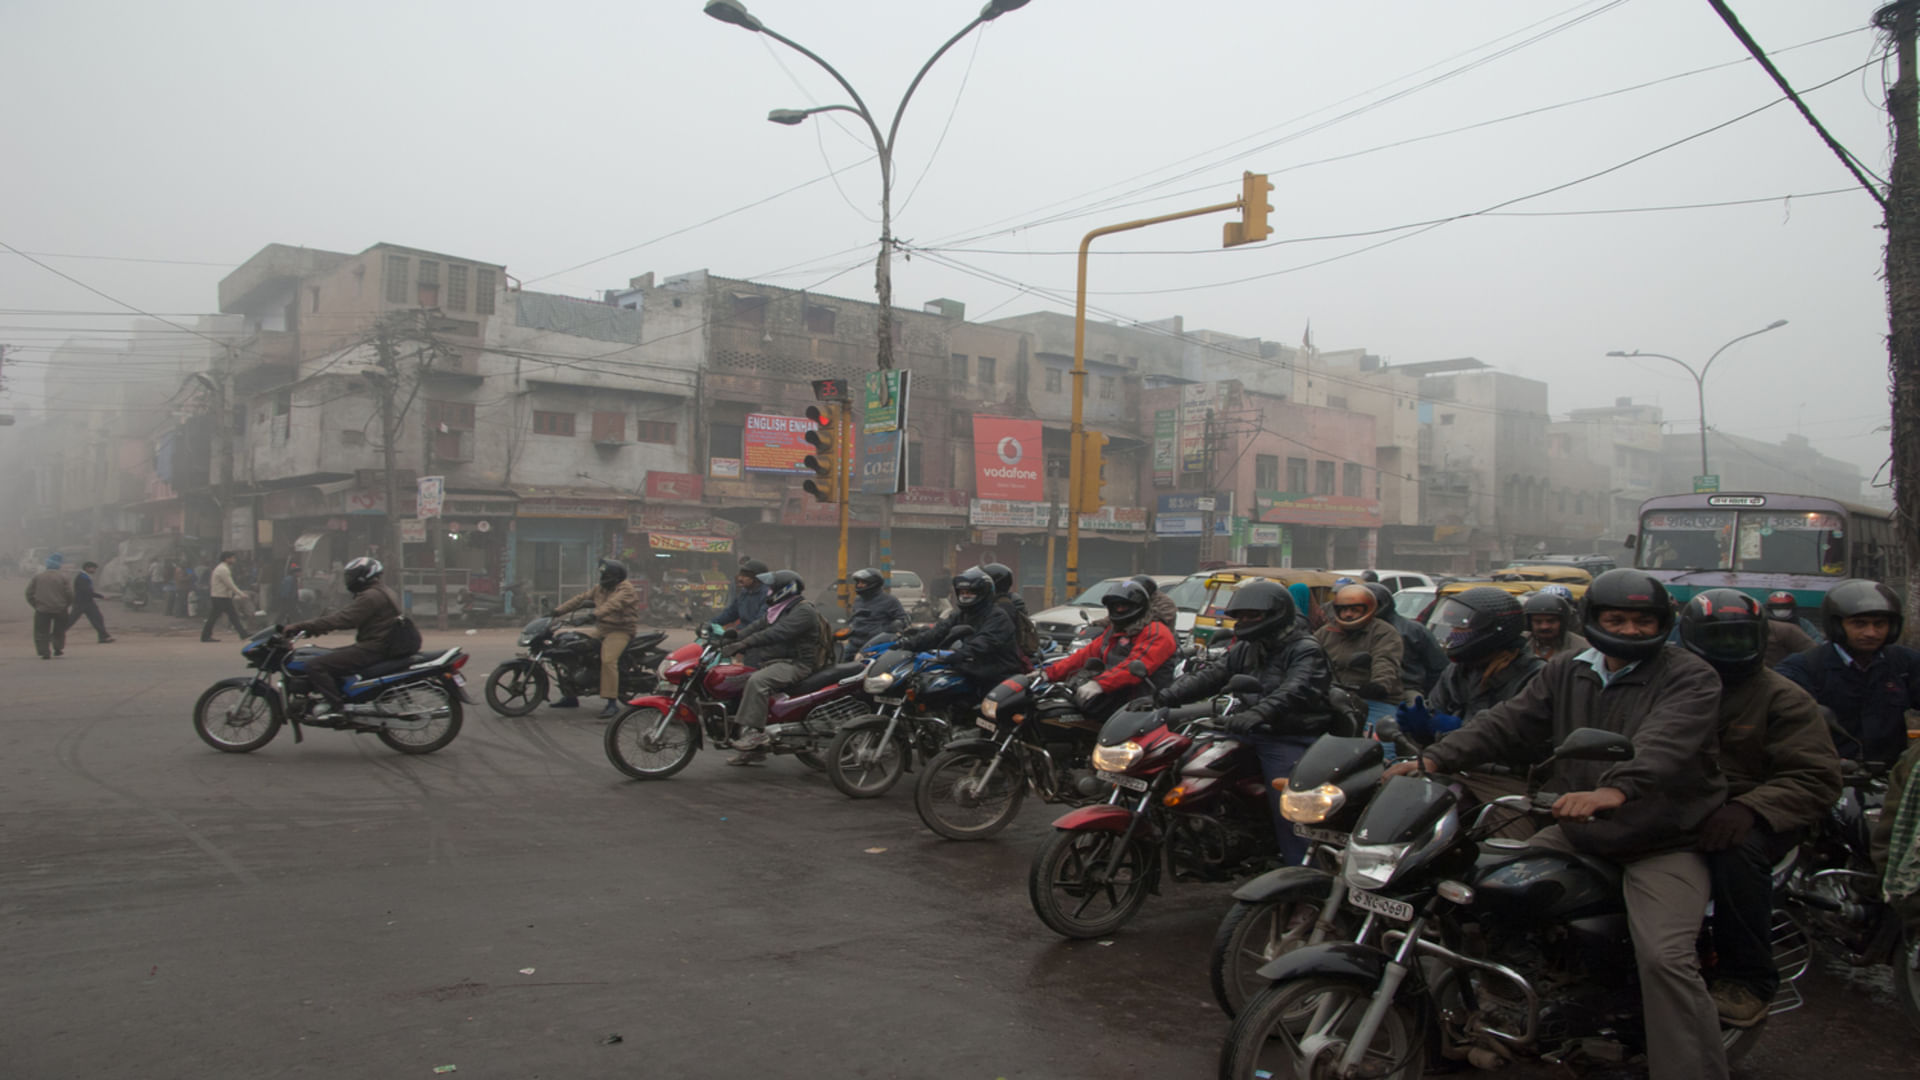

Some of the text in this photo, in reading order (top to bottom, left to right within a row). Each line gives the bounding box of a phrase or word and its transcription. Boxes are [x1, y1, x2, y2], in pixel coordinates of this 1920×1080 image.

[747, 416, 818, 433] ENGLISH ENHAN
[983, 467, 1037, 480] vodafone
